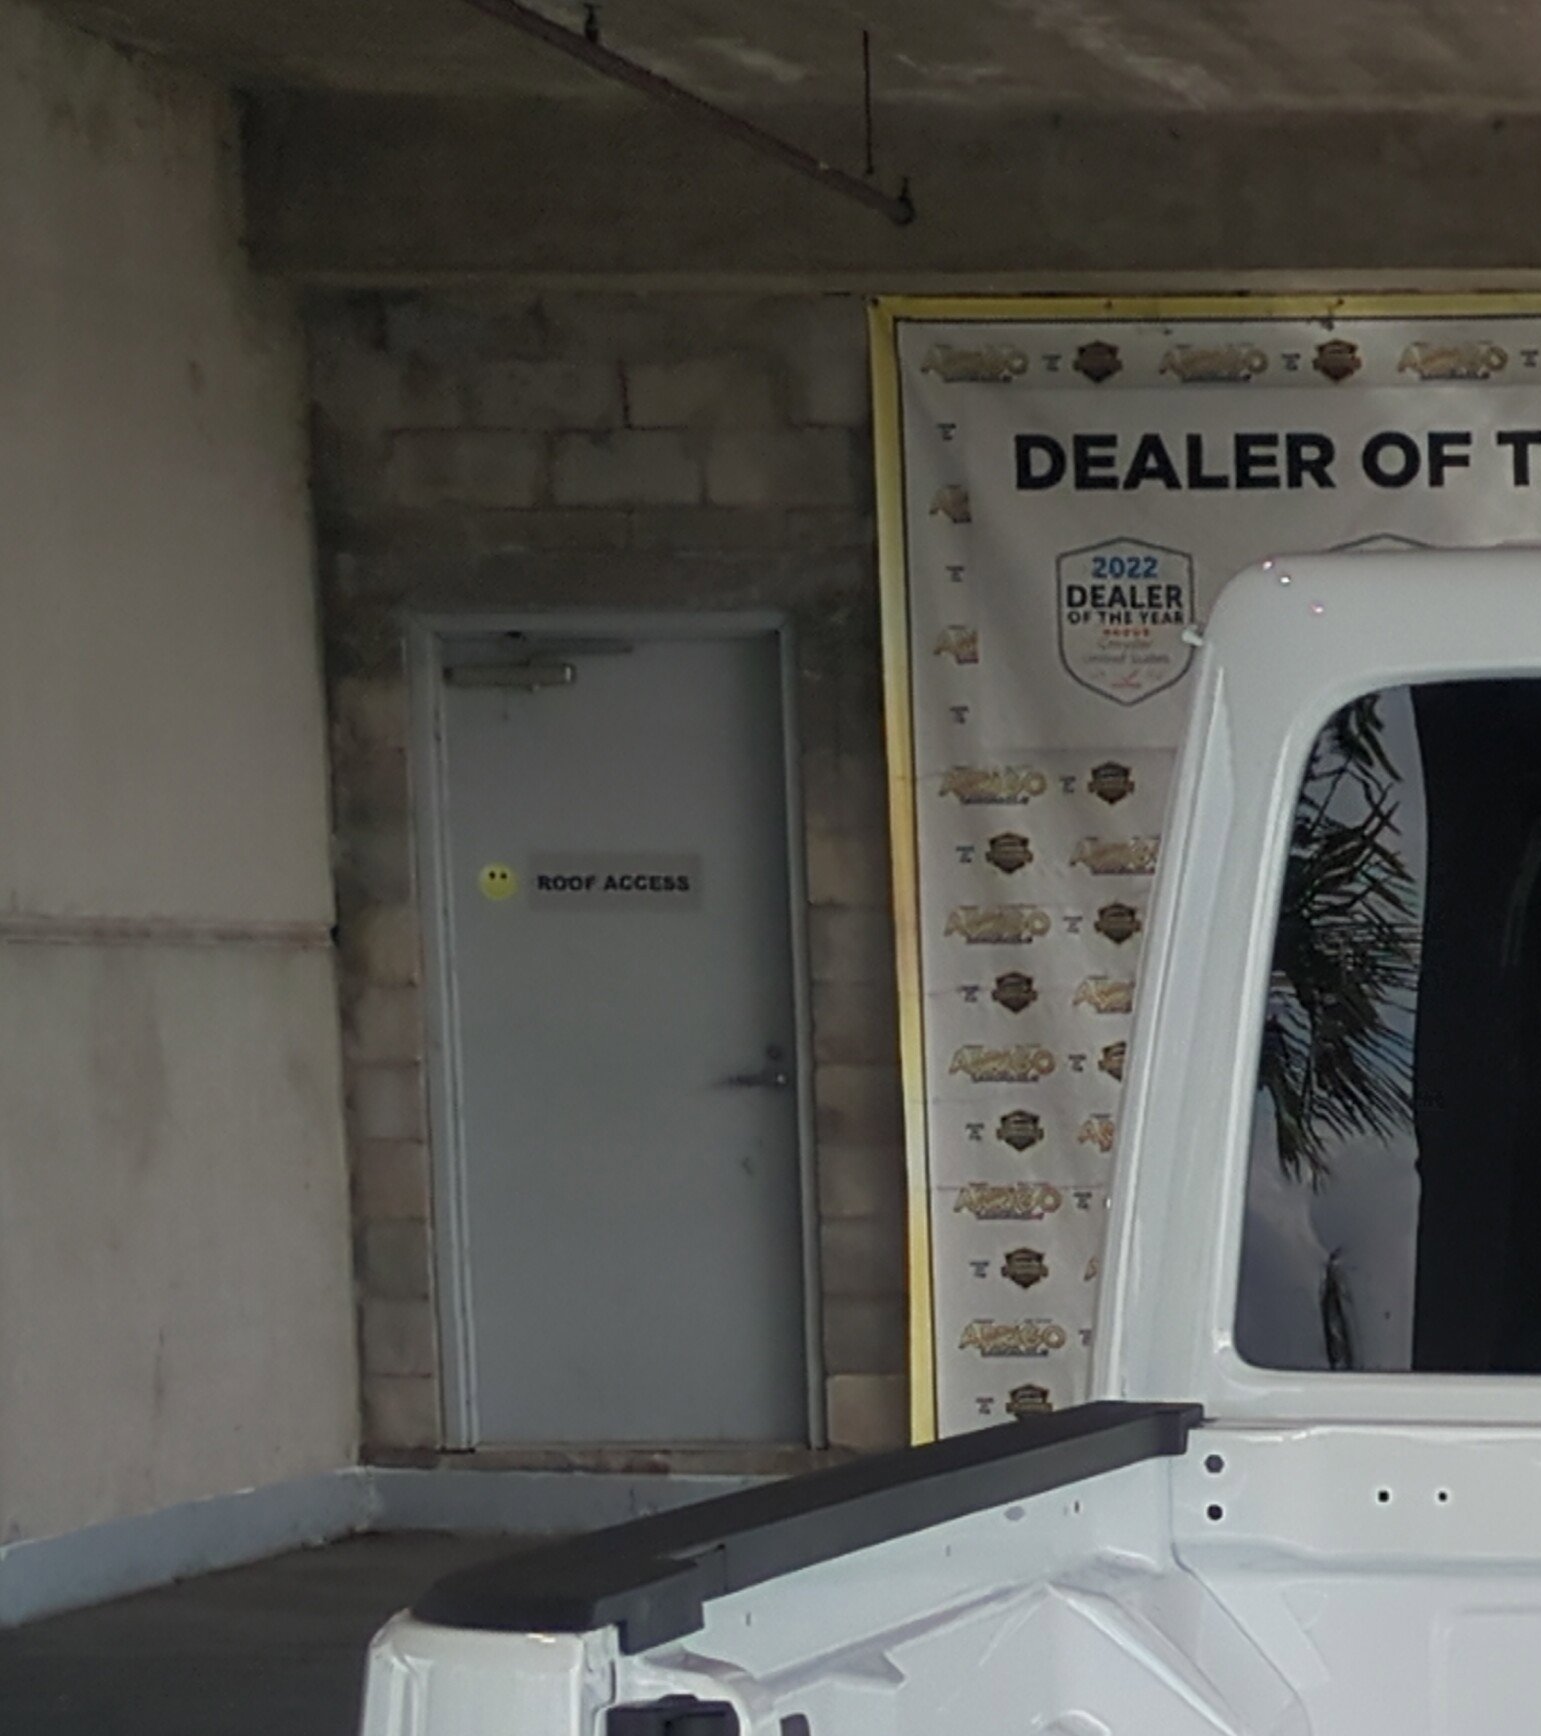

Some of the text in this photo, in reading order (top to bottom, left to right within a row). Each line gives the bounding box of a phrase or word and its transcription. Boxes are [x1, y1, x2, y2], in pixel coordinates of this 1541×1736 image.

[1014, 433, 1336, 491] DEALER
[1361, 431, 1472, 489] OF
[1091, 556, 1158, 579] 2022
[1066, 584, 1184, 610] DEALER
[1067, 611, 1184, 625] OF THE YEAR
[537, 875, 690, 891] ROOF ACCESS
